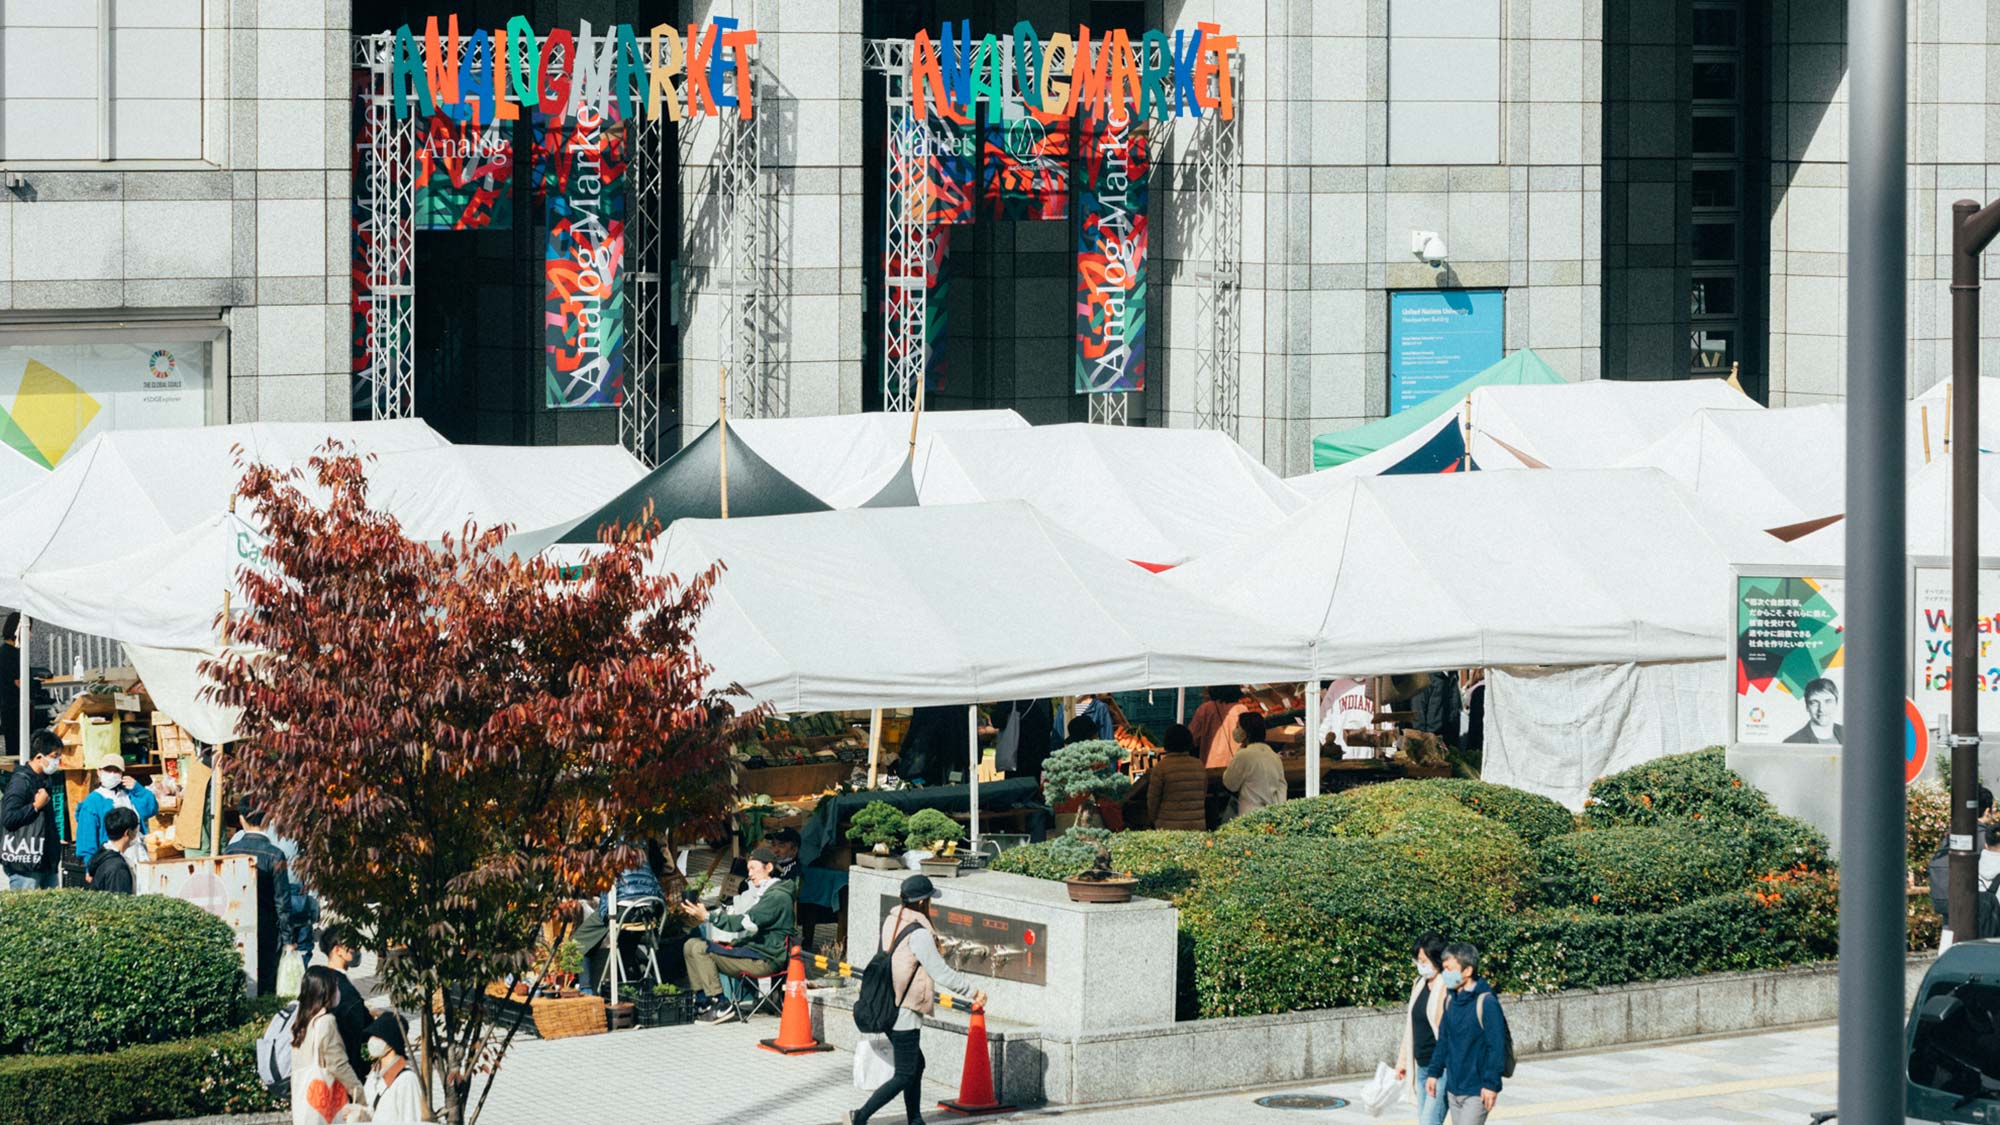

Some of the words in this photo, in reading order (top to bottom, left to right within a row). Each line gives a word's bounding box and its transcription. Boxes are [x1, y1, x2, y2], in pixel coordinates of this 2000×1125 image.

[419, 132, 508, 166] Analog
[569, 104, 601, 237] Marke
[1098, 106, 1129, 230] Marke
[569, 245, 610, 391] Analog
[1094, 238, 1134, 377] Analog
[1924, 609, 2000, 633] Wat
[1925, 640, 1992, 664] yor
[1925, 666, 2000, 692] ida?
